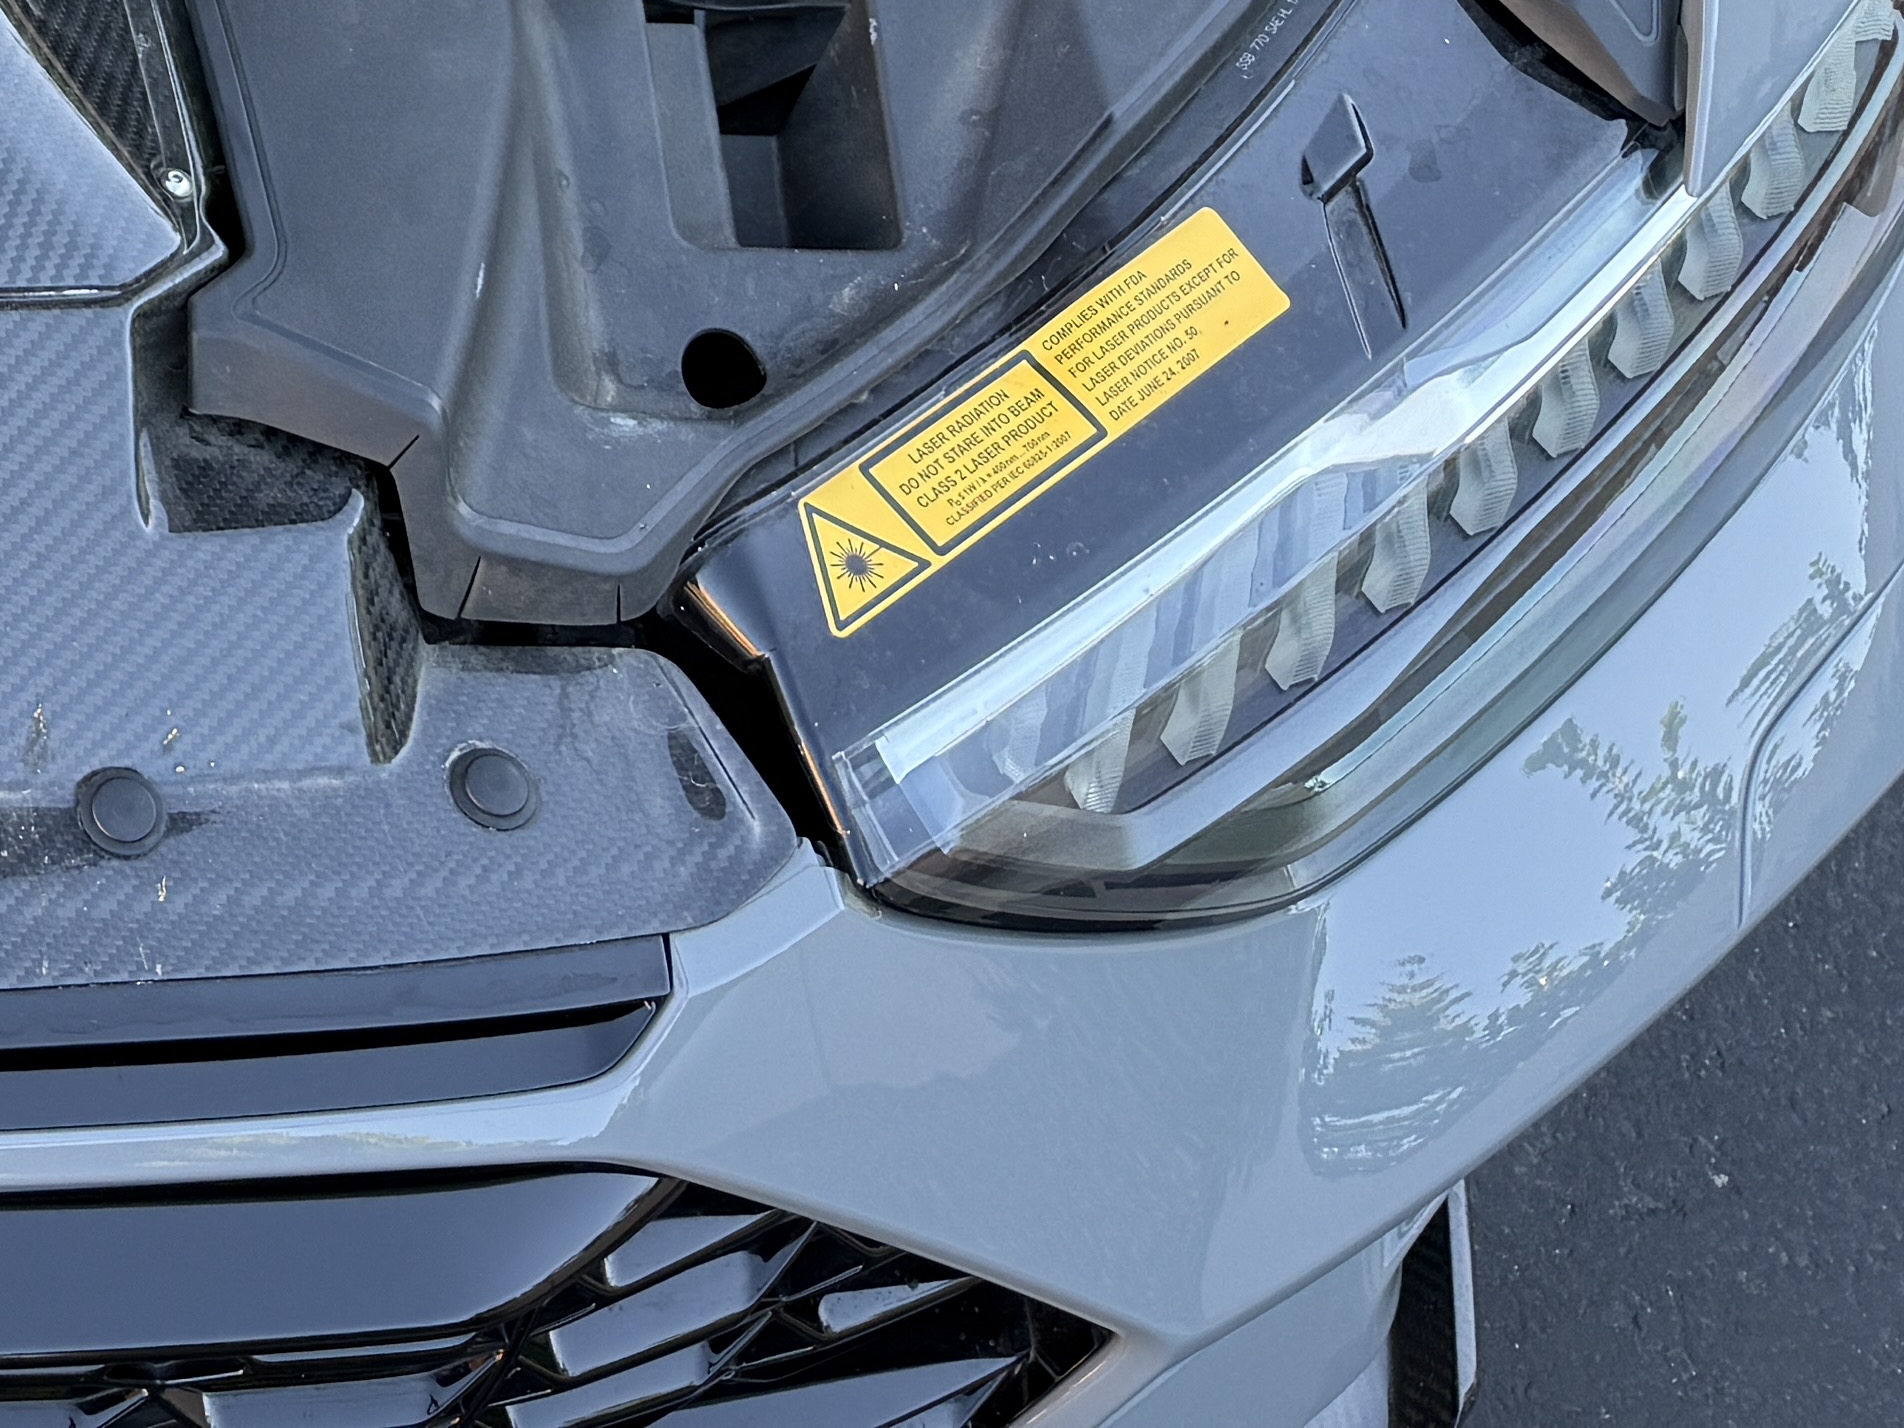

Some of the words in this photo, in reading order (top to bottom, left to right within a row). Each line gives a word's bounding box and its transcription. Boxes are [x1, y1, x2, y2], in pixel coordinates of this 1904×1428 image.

[1040, 303, 1099, 353] COMPLIES
[1095, 283, 1126, 311] WITH
[1122, 267, 1147, 290] FDA
[1053, 299, 1136, 366] PERFORMANCE
[1132, 256, 1193, 307] STANDARDS
[1067, 354, 1095, 379] FOR
[1091, 329, 1129, 361] LASER
[1126, 289, 1182, 335] PRODUCTS
[1177, 262, 1218, 297] EXCEPT
[1214, 246, 1240, 269] FOR
[1082, 360, 1120, 392] LASER
[1116, 317, 1177, 366] DEVIATIONS
[1172, 279, 1227, 324] PURSUANT
[1223, 268, 1242, 285] TO
[1095, 375, 1133, 406] LASER
[1129, 348, 1169, 381] NOTICE
[1165, 334, 1187, 354] NO.
[1108, 395, 1139, 421] DATE
[1134, 375, 1165, 401] JUNE
[1175, 347, 1202, 370] 2007
[897, 475, 921, 496] DO
[916, 457, 947, 482] NOT
[941, 431, 984, 464] STARE
[979, 411, 1011, 437] INTO
[1006, 386, 1046, 417] BEAM
[906, 430, 950, 464] LASER
[945, 388, 1010, 437] RADIATION
[914, 474, 958, 509] CLASS
[954, 468, 967, 480] 2
[962, 440, 1005, 474] LASER
[1000, 400, 1061, 446] PRODUCT
[943, 488, 994, 527] CLASSIFIED
[990, 475, 1011, 493] PER
[1007, 465, 1025, 480] IEC
